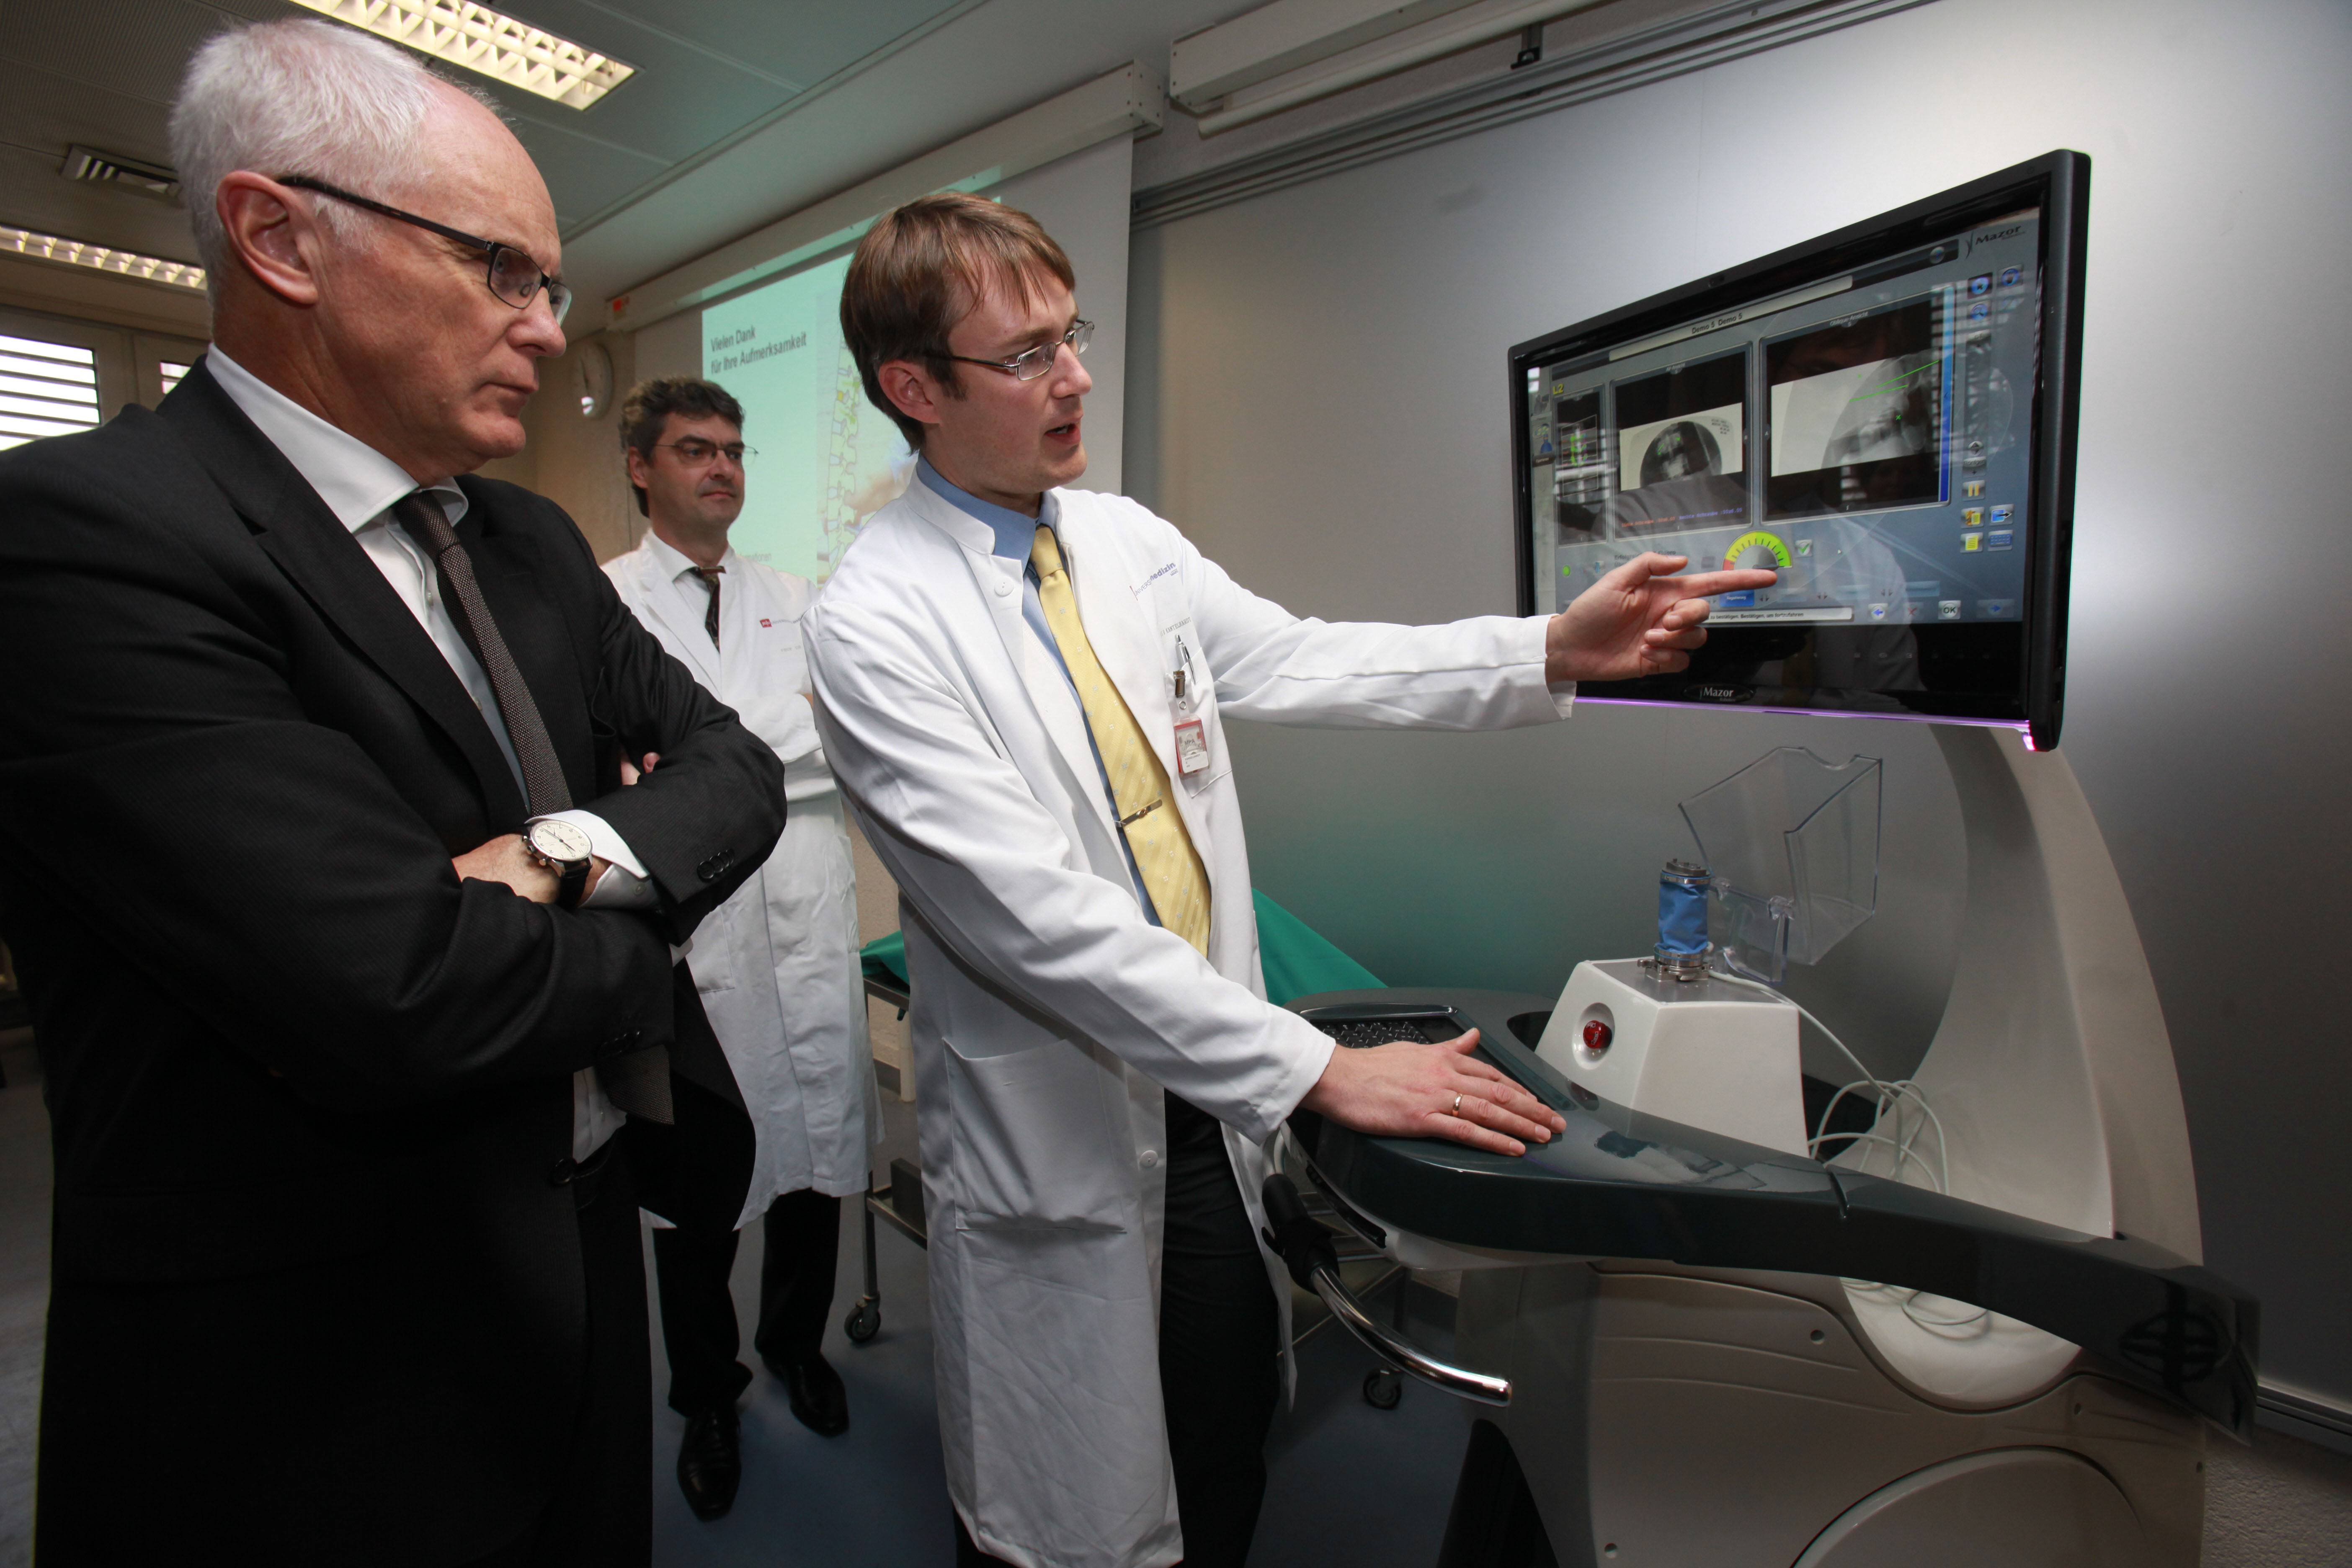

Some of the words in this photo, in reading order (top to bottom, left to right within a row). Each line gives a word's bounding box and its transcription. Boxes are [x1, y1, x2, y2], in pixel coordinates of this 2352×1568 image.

[1975, 226, 2021, 245] Mazor
[1692, 322, 1710, 334] Demo
[1718, 316, 1736, 326] Demo
[711, 335, 734, 352] Vielen
[736, 325, 756, 344] Dank
[711, 359, 721, 373] für
[723, 356, 738, 370] Ihre
[740, 331, 806, 365] Aufmerksamkeit
[1553, 384, 1564, 395] L2
[1703, 687, 1734, 697] Mazor
